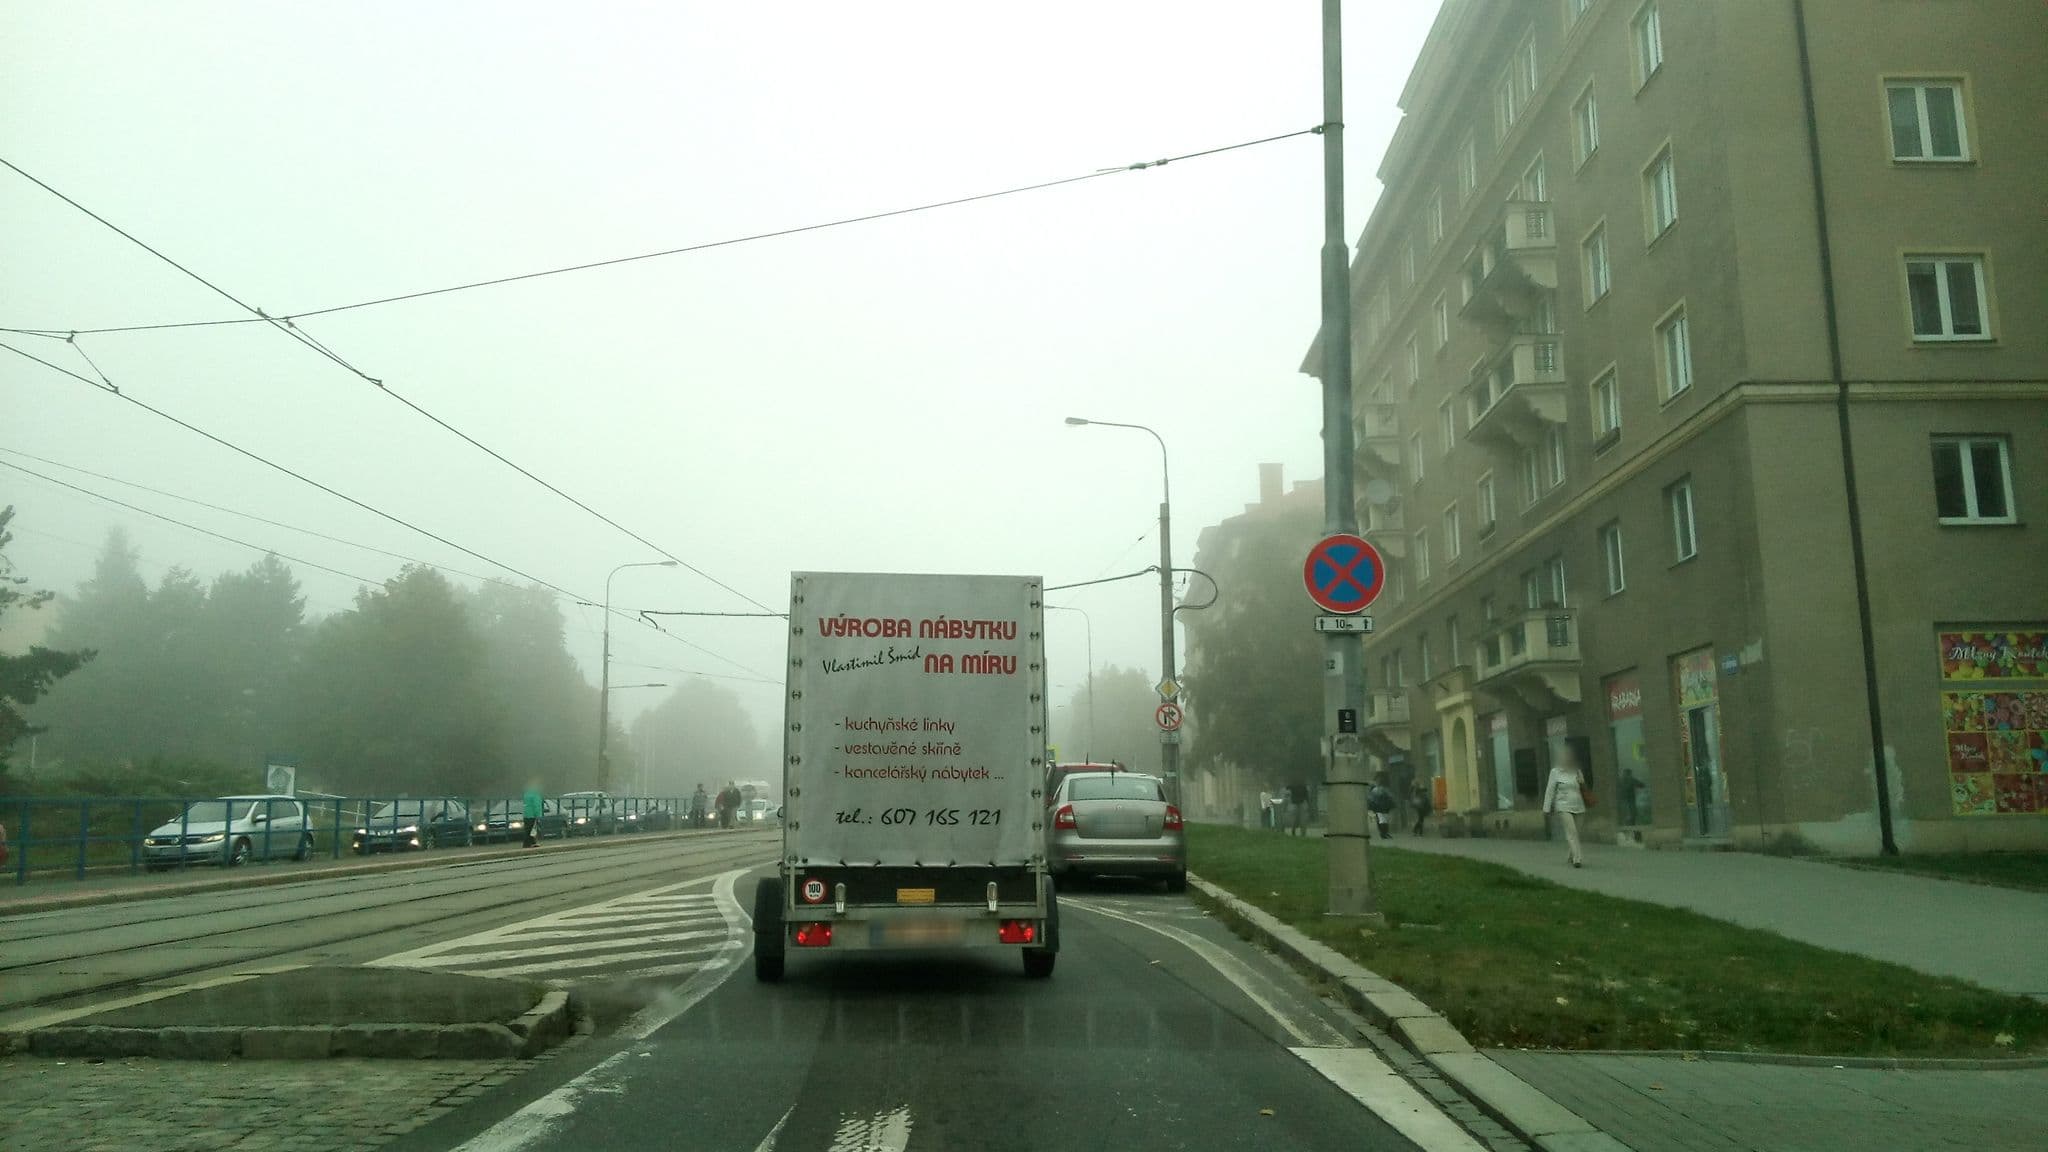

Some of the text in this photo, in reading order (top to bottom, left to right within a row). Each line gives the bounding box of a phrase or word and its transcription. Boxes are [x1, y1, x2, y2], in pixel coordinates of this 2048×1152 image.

[818, 613, 1017, 640] VÝROBA NÁBYTKU
[822, 646, 921, 675] Vlastimil Šmíd
[924, 650, 1017, 675] NA MÍRU
[845, 716, 919, 735] kuchyňské
[923, 717, 955, 735] linky
[844, 741, 917, 755] vestavěné
[922, 742, 962, 756] skříně
[844, 765, 927, 783] kancelářský
[931, 765, 990, 783] nábytek
[835, 808, 1001, 826] tel.: 607 165 121
[808, 883, 821, 894] 100
